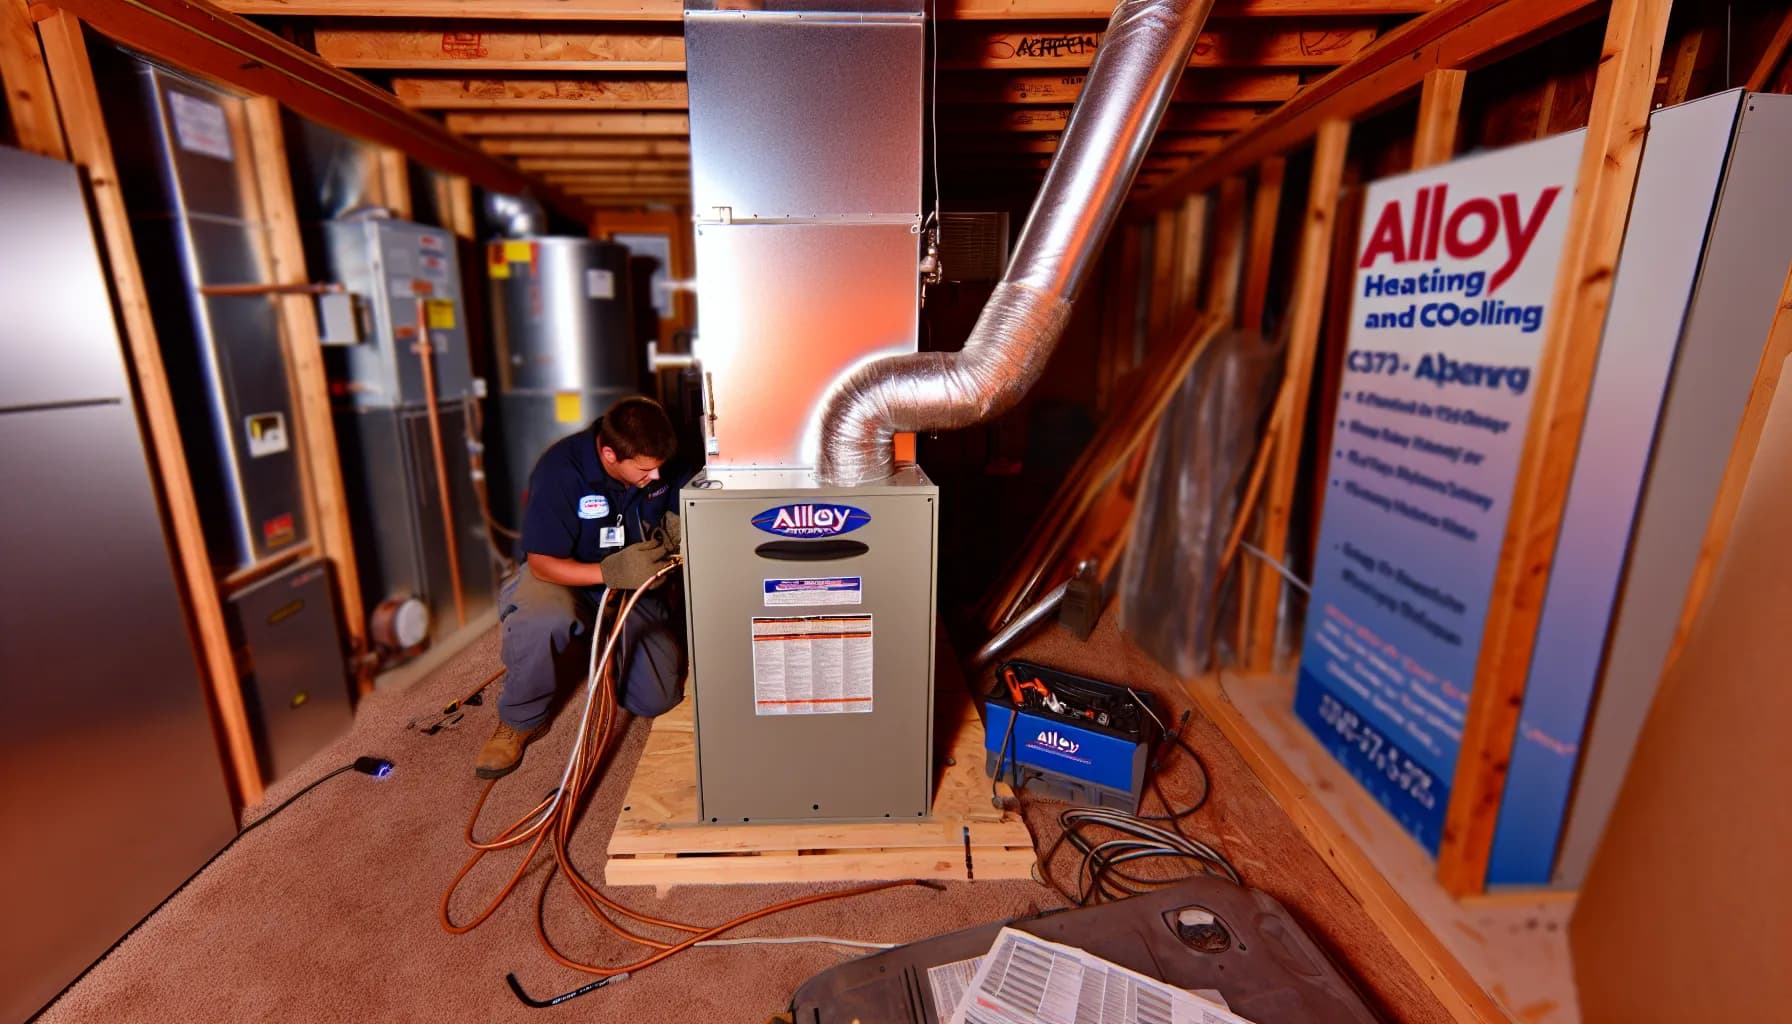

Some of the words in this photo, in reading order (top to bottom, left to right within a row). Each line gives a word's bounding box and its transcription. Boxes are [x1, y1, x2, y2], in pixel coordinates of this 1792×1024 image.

[1359, 183, 1563, 296] Alloy
[1364, 304, 1416, 329] and
[1037, 731, 1080, 753] Alloy
